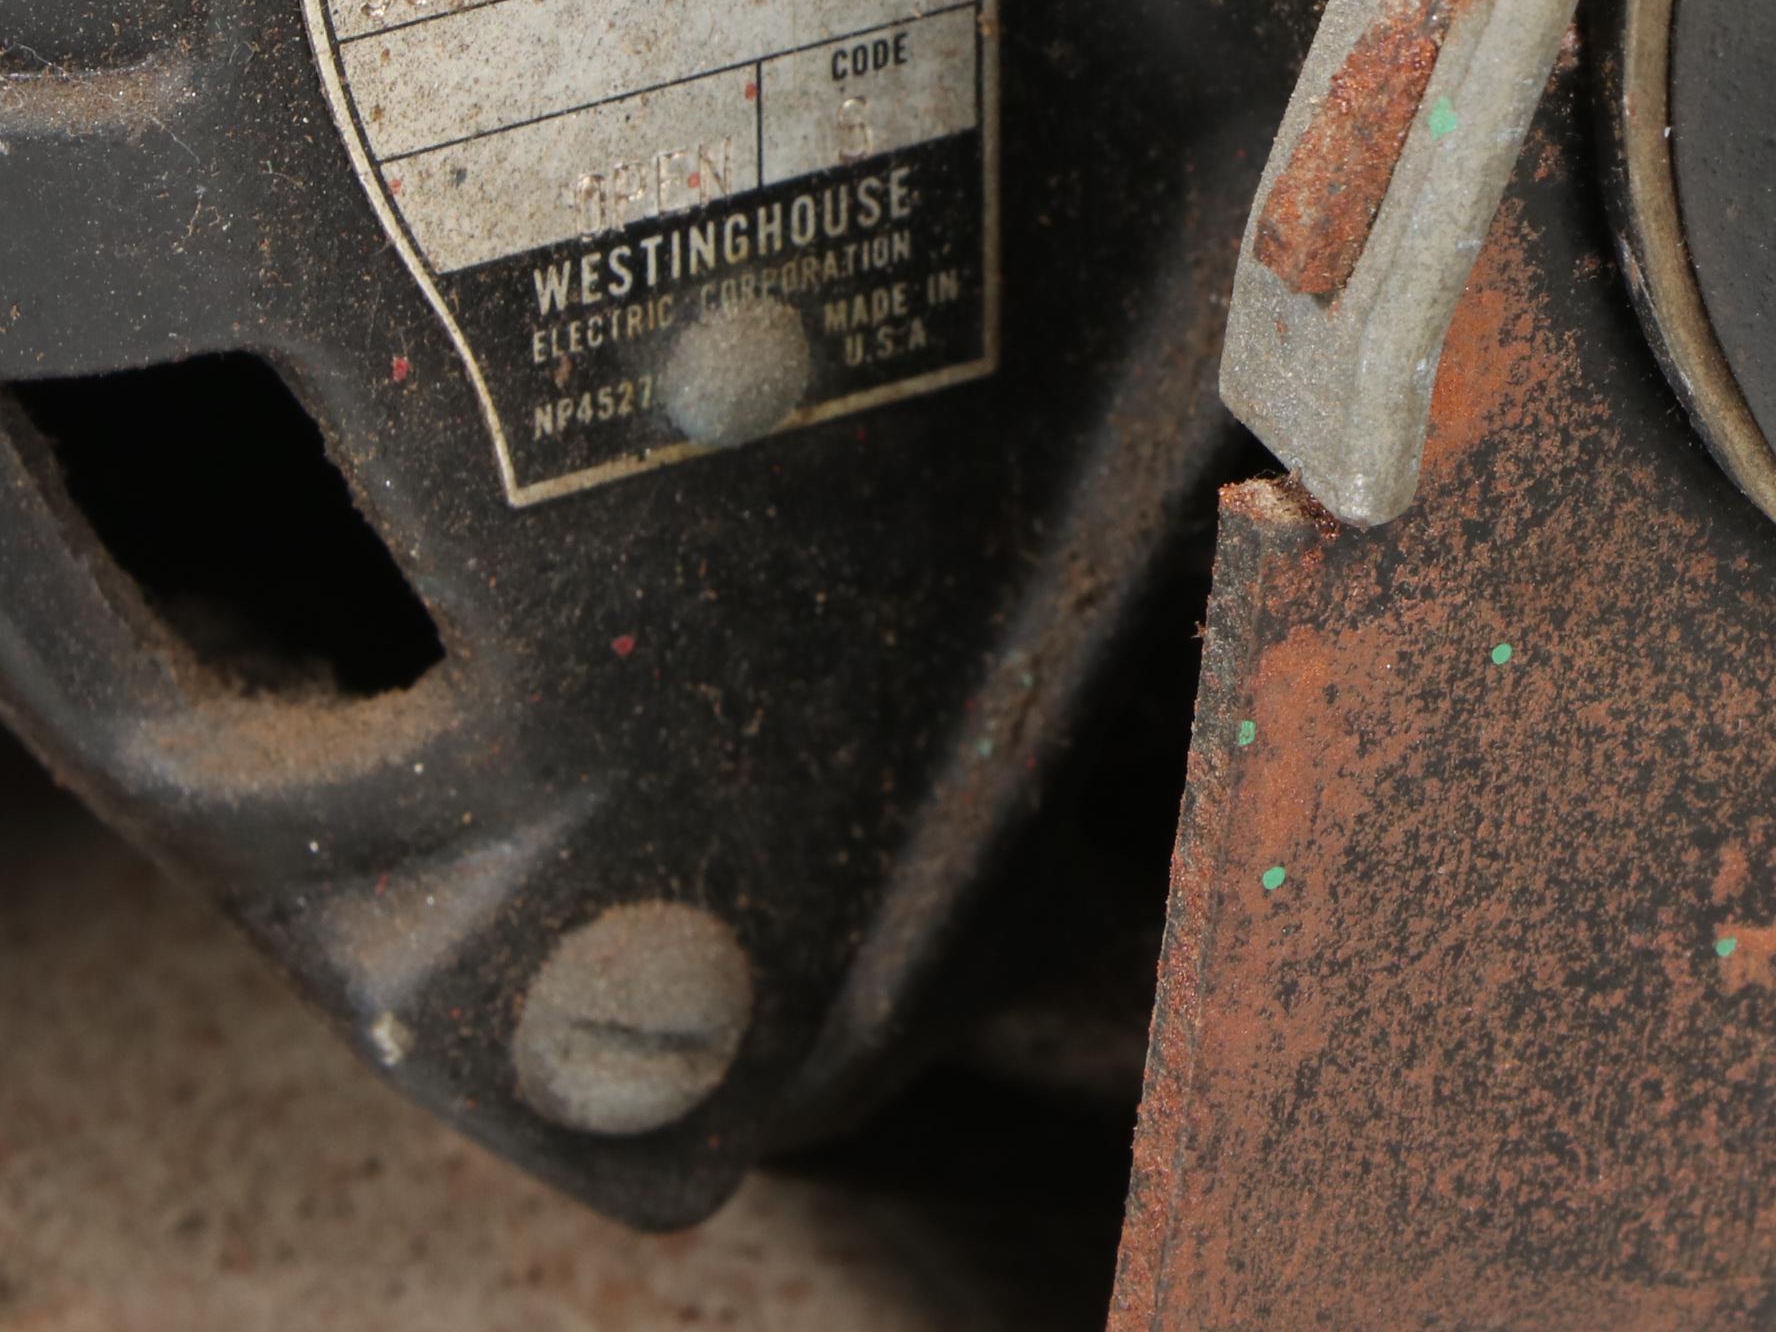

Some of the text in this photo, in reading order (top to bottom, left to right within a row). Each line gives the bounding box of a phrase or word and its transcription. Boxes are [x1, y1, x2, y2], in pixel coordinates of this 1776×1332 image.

[831, 31, 909, 83] CODE
[532, 168, 912, 316] WESTINGHOUSE
[532, 229, 911, 364] ELECTRIC CORPORATION
[824, 268, 961, 333] MADE IN
[533, 374, 654, 442] NP4527
